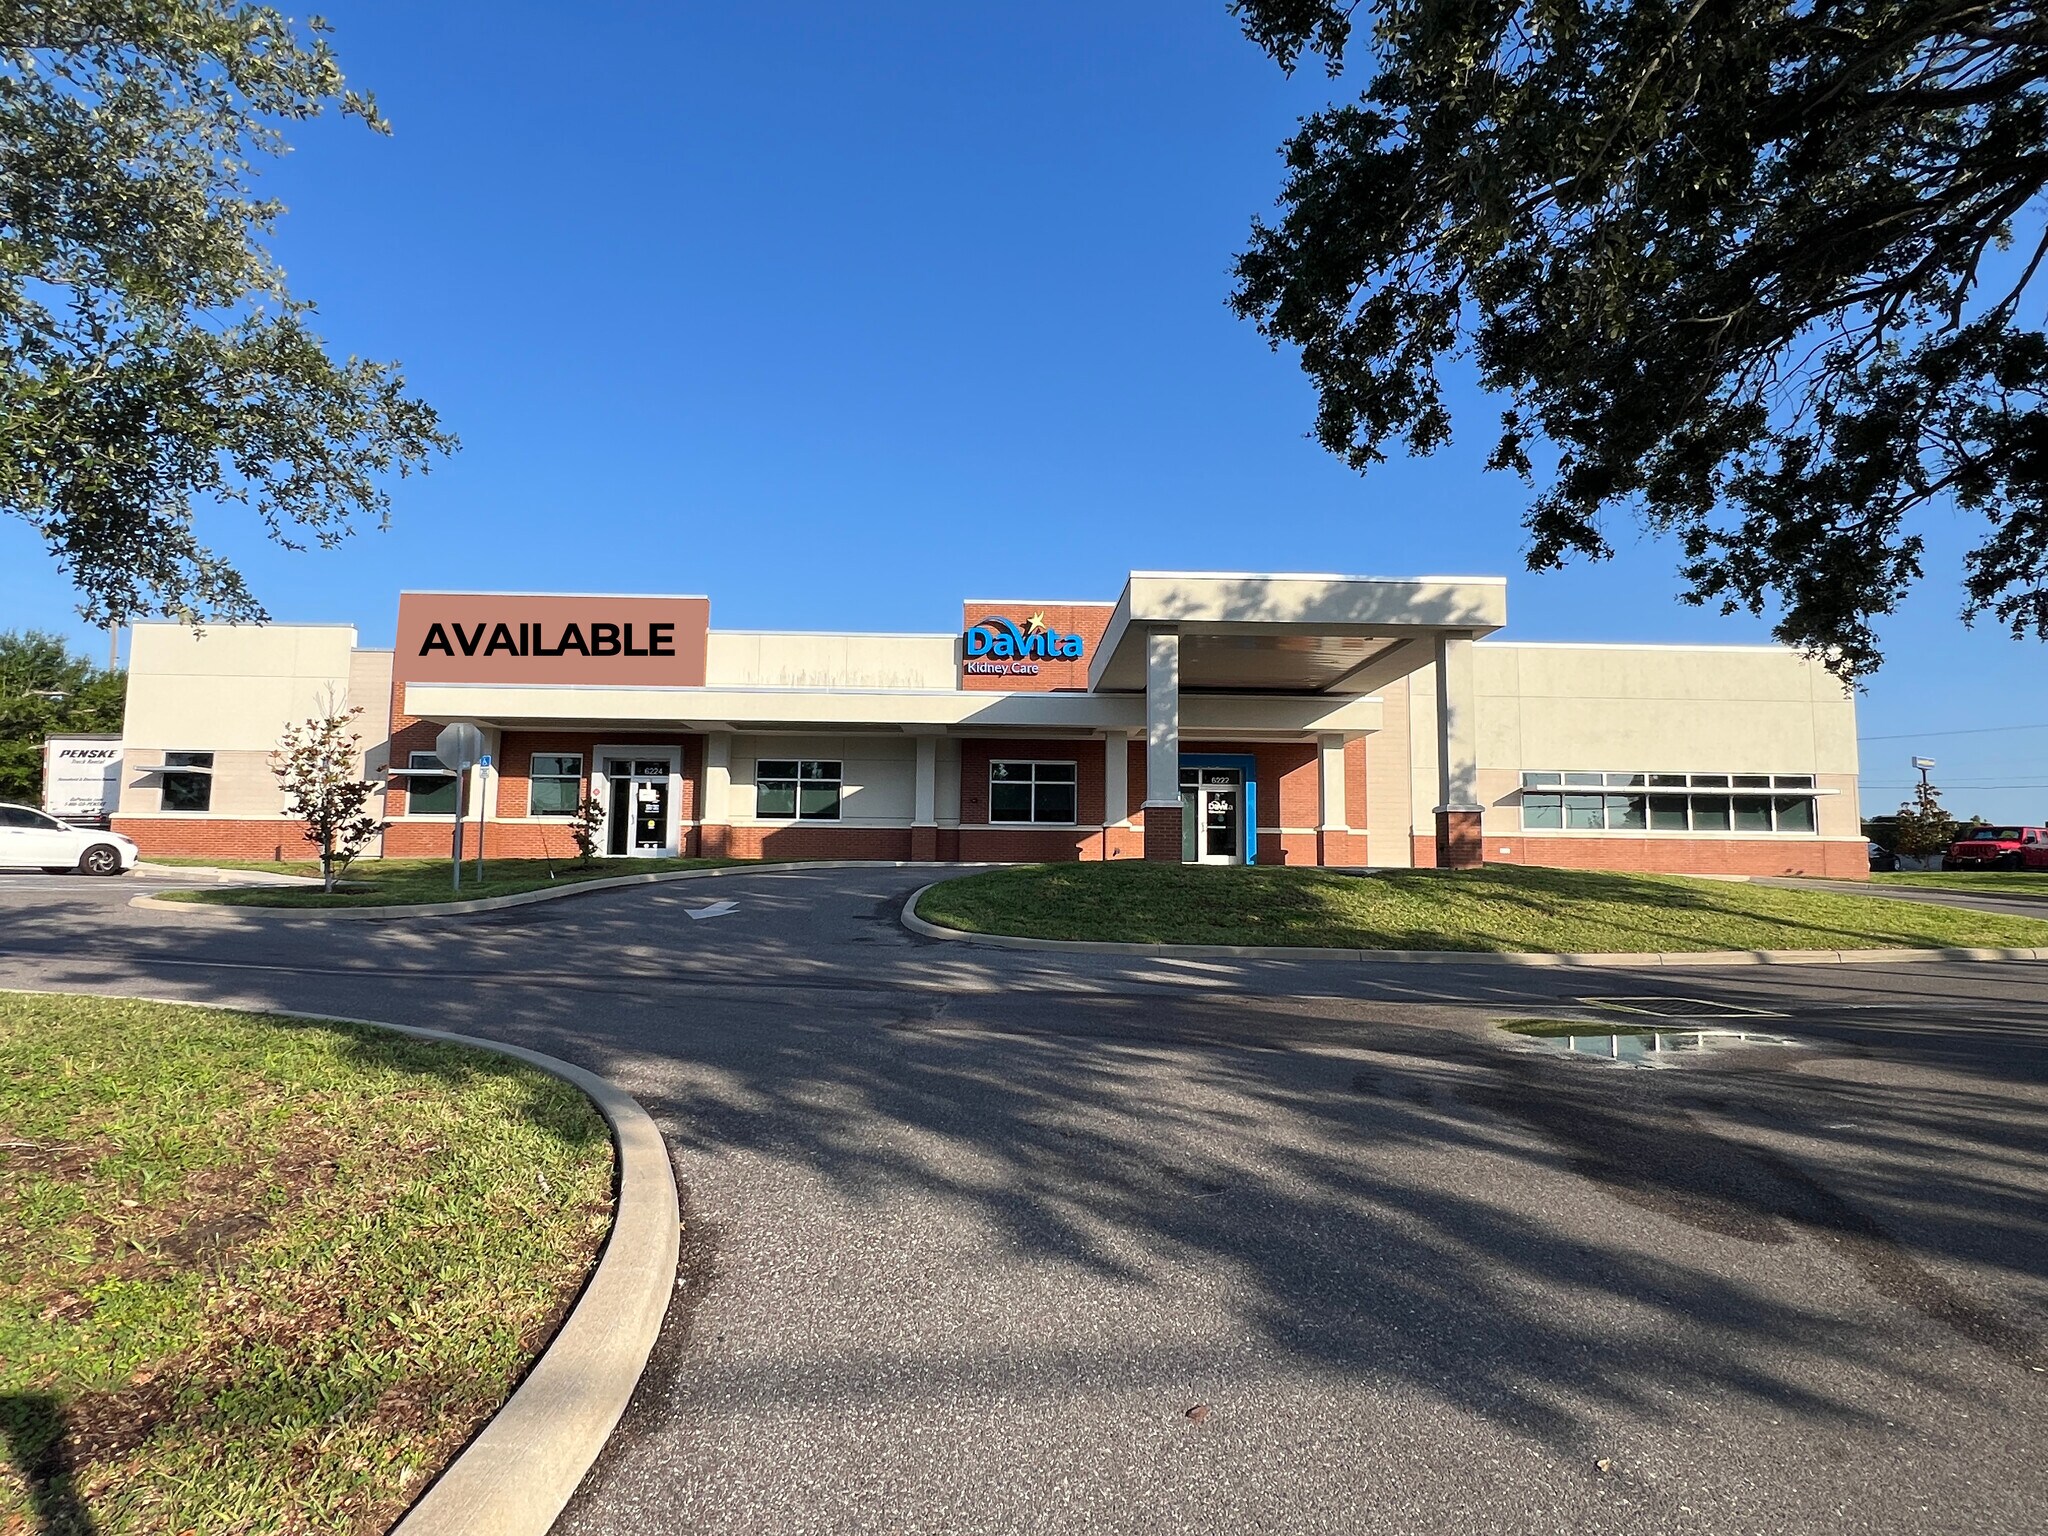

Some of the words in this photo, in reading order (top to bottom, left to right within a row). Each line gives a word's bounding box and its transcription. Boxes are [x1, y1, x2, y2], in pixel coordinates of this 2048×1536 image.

[967, 615, 1084, 657] DaVita
[967, 662, 1009, 675] Kidney
[1011, 662, 1039, 673] Care
[59, 749, 118, 758] PENSKE
[644, 767, 663, 775] 6224
